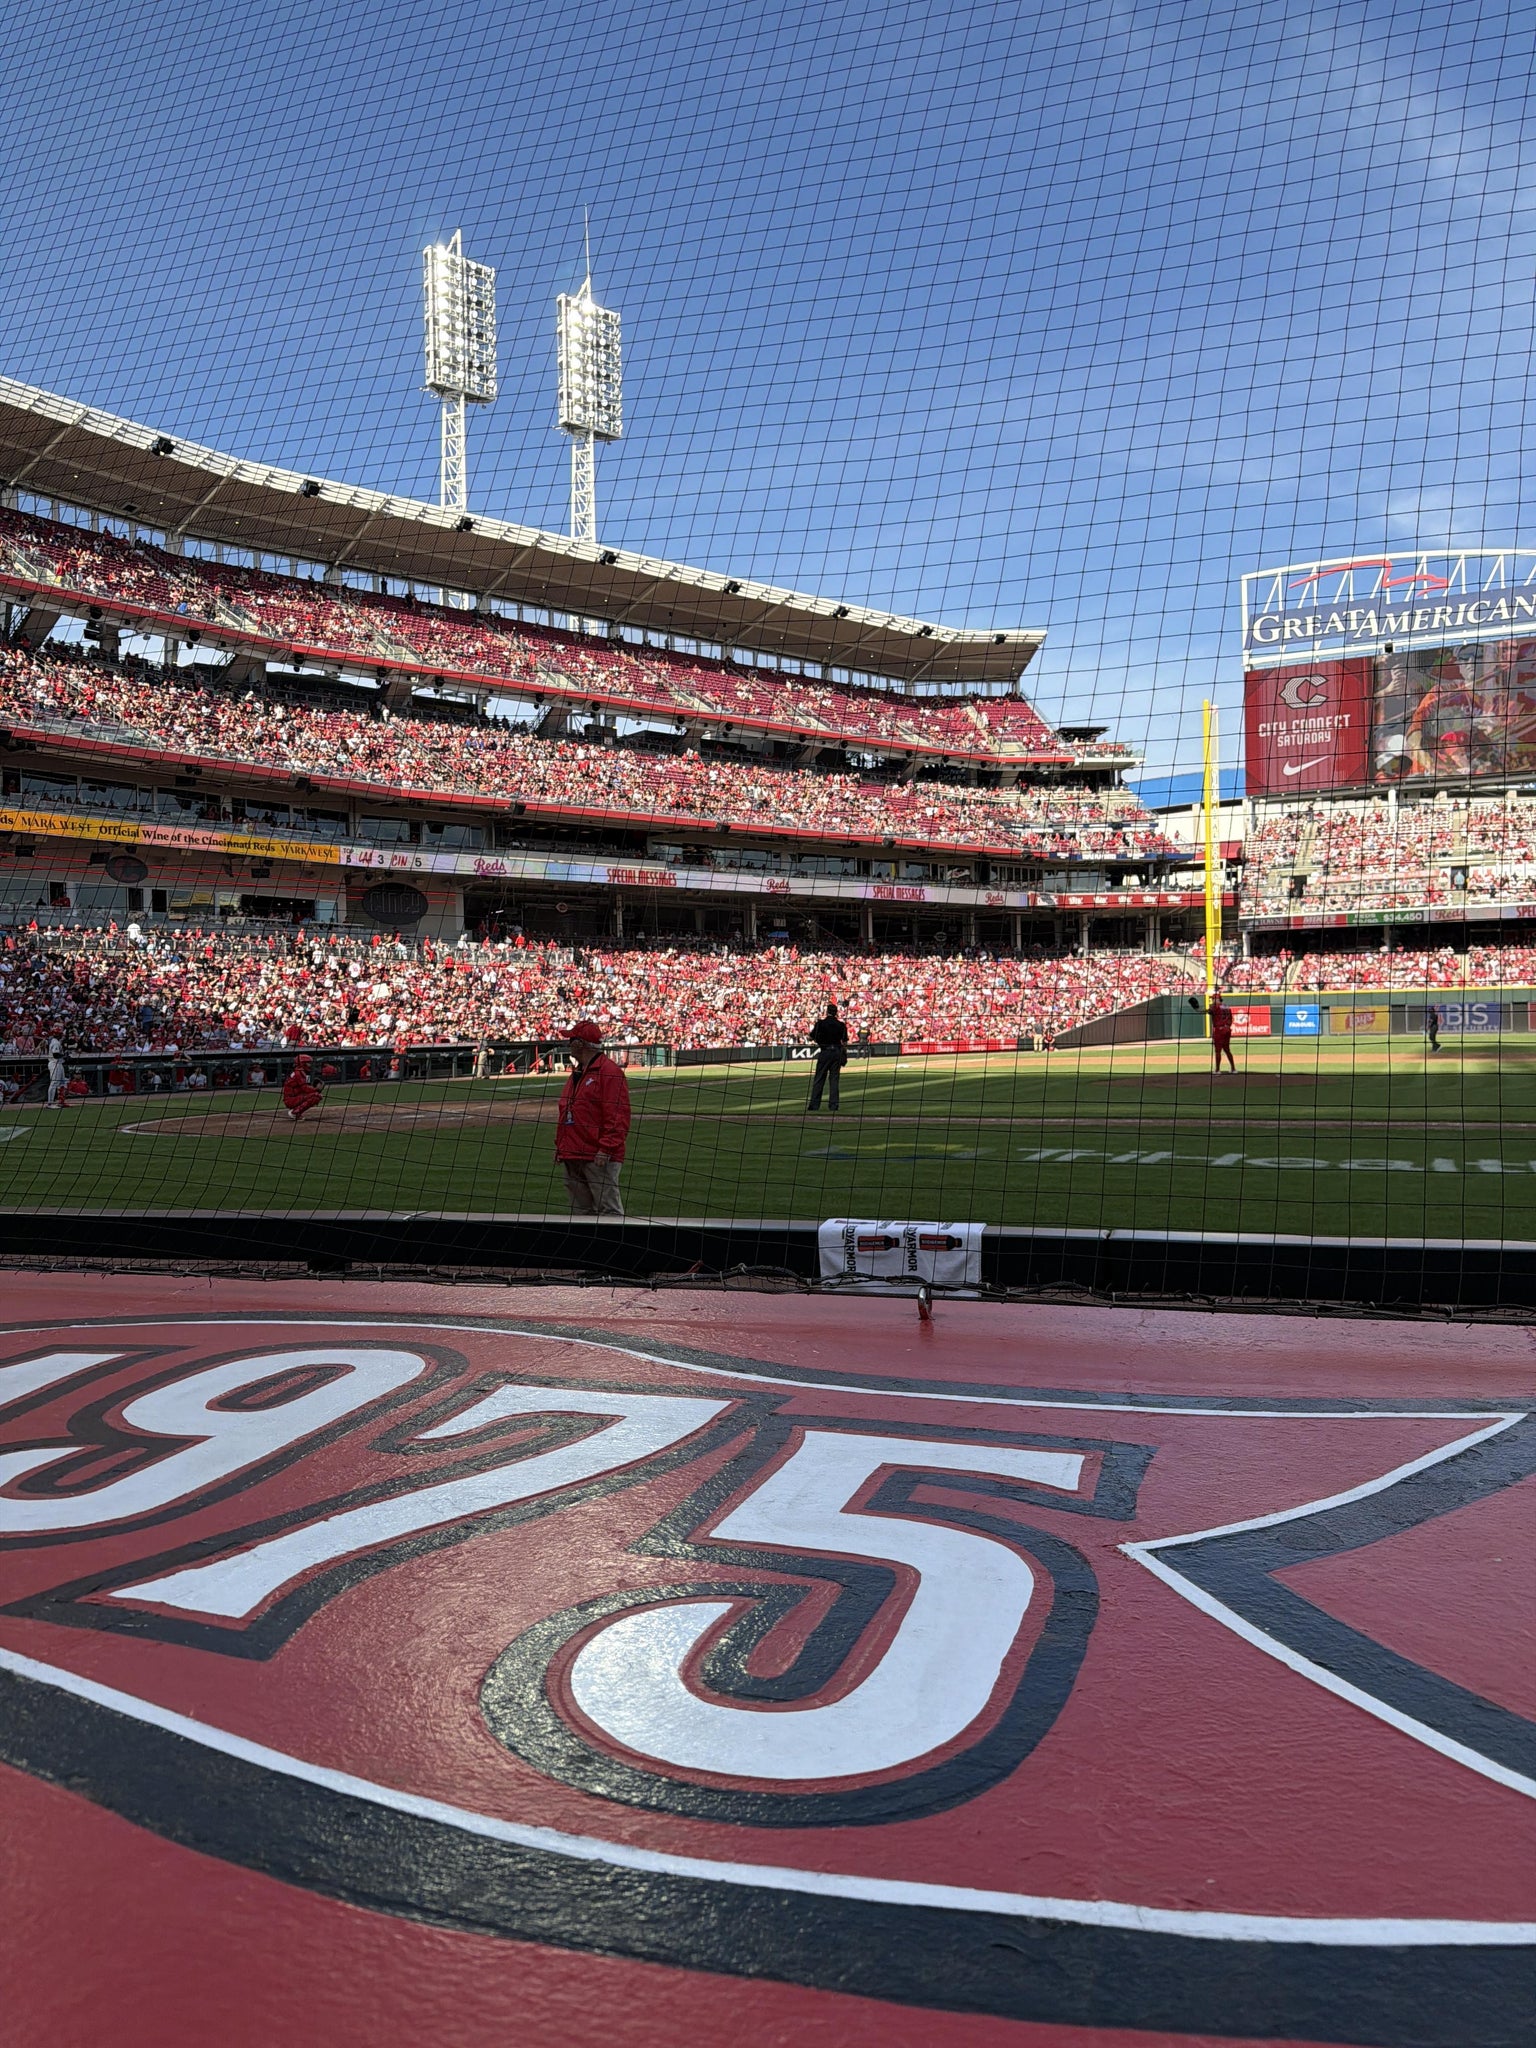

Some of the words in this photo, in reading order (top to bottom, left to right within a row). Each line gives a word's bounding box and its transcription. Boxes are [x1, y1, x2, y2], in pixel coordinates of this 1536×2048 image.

[1253, 612, 1365, 643] GREAT
[1353, 594, 1536, 638] AMERICAN
[1258, 722, 1287, 738] CITY
[1291, 714, 1351, 733] CONNECT
[1277, 731, 1331, 748] SATURDAY
[0, 815, 14, 825] ds
[21, 816, 57, 829] MARK
[60, 820, 93, 832] WEST
[99, 825, 140, 838] Official
[142, 829, 169, 841] Wine
[171, 833, 181, 843] of
[184, 834, 200, 844] the
[201, 835, 251, 850] Cincinnati
[253, 842, 276, 853] Reds
[281, 844, 307, 856] MARK
[310, 846, 335, 858] WEST
[377, 855, 385, 865] 3
[391, 853, 408, 867] CIN
[415, 857, 422, 868] 5
[473, 857, 507, 876] Reds
[607, 868, 637, 885] SPECIAL
[638, 869, 677, 887] MESSAGES
[767, 878, 792, 894] Reds
[872, 885, 895, 899] SPECIAL
[896, 886, 926, 901] MESSAGES
[984, 891, 1005, 906] Reds
[1383, 911, 1423, 923] $34,450
[1446, 1003, 1489, 1026] BIS
